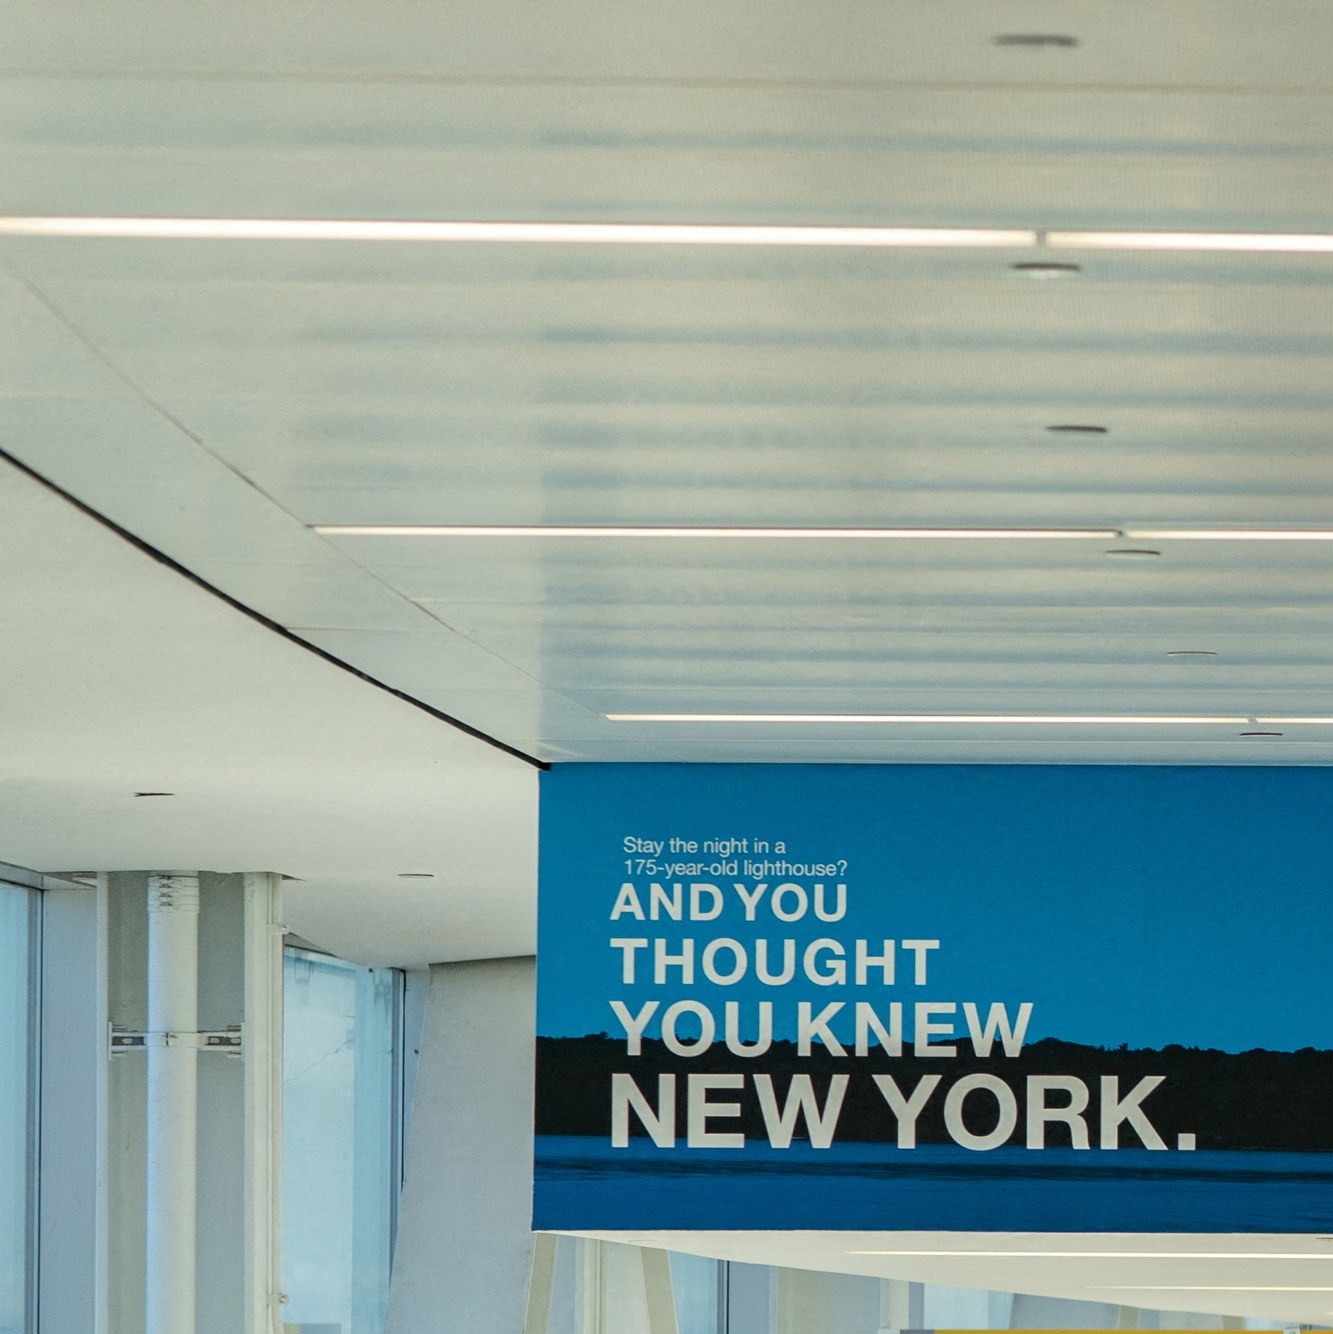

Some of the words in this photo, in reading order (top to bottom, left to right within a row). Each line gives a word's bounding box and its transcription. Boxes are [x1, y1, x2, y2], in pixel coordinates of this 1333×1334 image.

[623, 836, 664, 857] Stay
[669, 837, 699, 854] the
[703, 837, 749, 857] night
[754, 838, 769, 854] in
[774, 841, 786, 854] a
[624, 858, 738, 879] 175-year-old
[744, 860, 848, 880] lighthouse?
[609, 882, 724, 921] AND
[733, 882, 847, 922] YOU
[610, 937, 940, 986] THOUGHT
[609, 1000, 773, 1057] YOU
[797, 1001, 1034, 1058] KNEW
[611, 1072, 850, 1149] NEW
[871, 1073, 1196, 1151] YORK.
